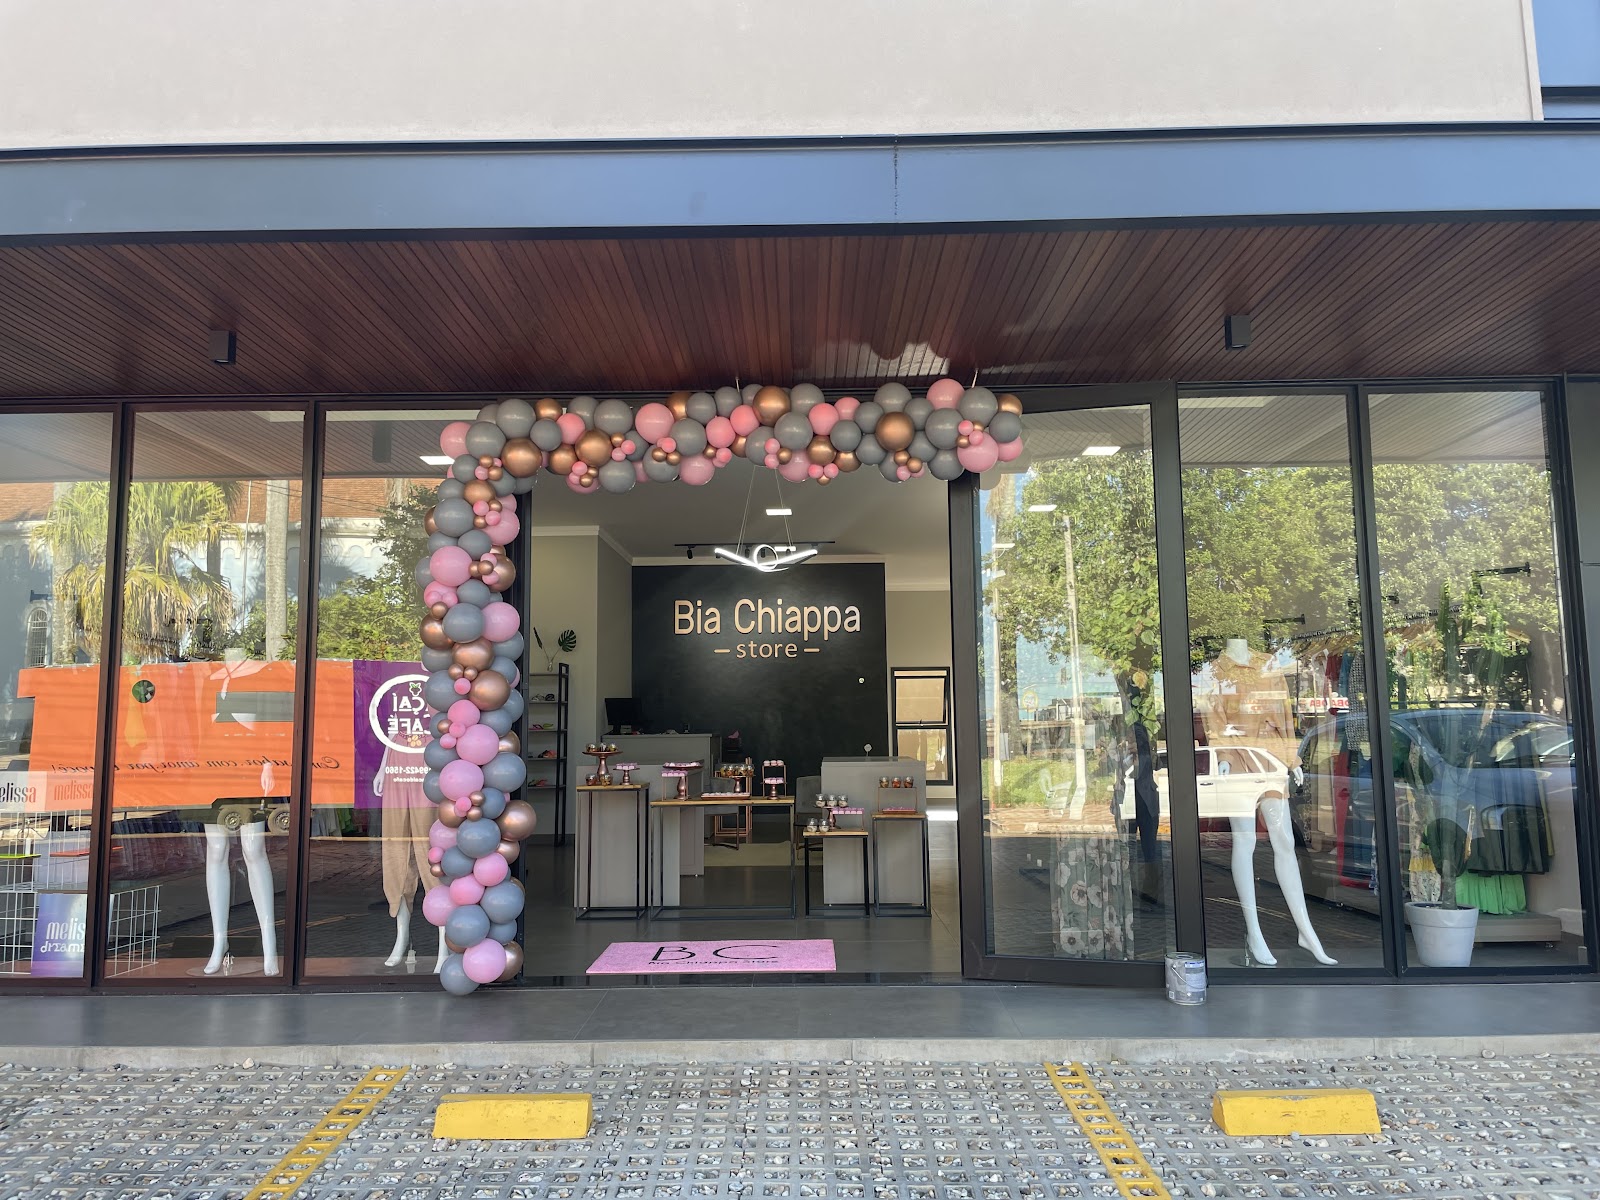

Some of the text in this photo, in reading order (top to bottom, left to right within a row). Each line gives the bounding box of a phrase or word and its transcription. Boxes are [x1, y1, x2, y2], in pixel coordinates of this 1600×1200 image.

[674, 598, 861, 641] Bia Chiappa
[736, 641, 798, 658] store
[0, 782, 37, 803] elissa
[46, 917, 86, 940] melis
